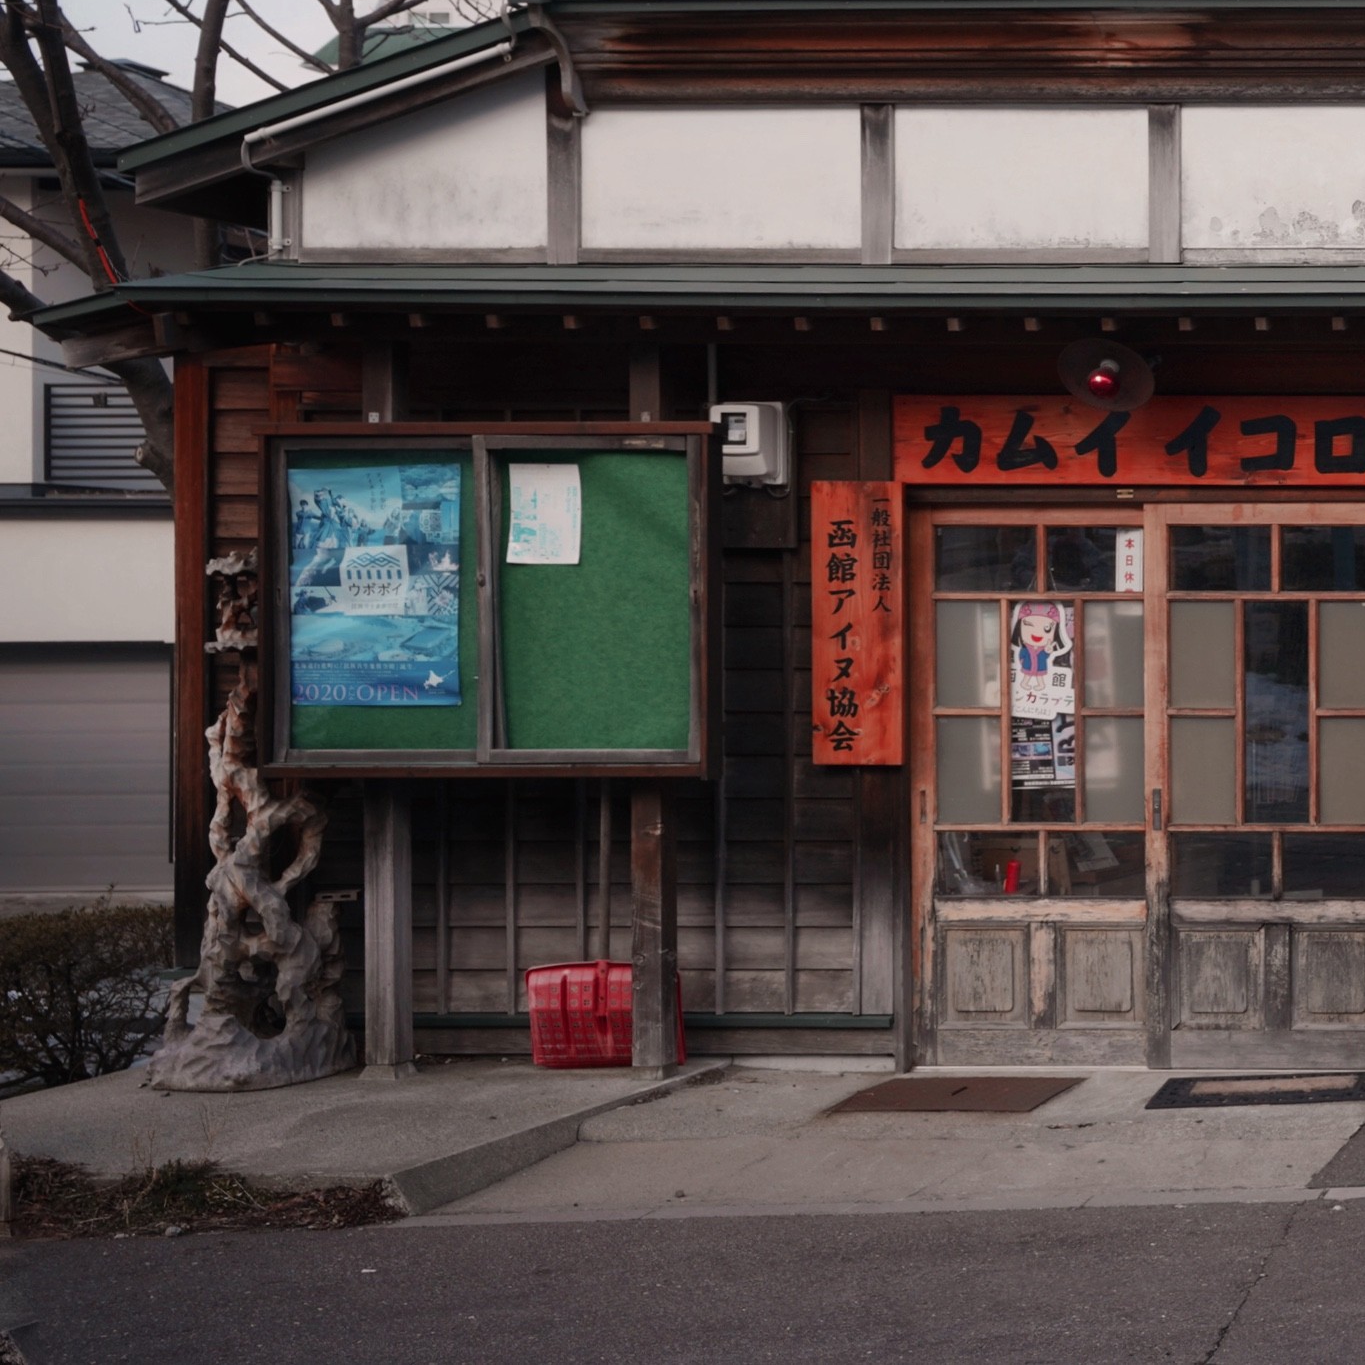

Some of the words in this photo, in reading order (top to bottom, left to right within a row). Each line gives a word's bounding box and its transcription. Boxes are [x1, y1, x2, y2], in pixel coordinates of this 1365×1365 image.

[871, 498, 891, 612] 一般社団法人
[348, 583, 402, 596] ウポポイ
[826, 519, 859, 751] 函館アイヌ協会
[295, 684, 347, 701] 2020
[356, 684, 419, 701] OPEN
